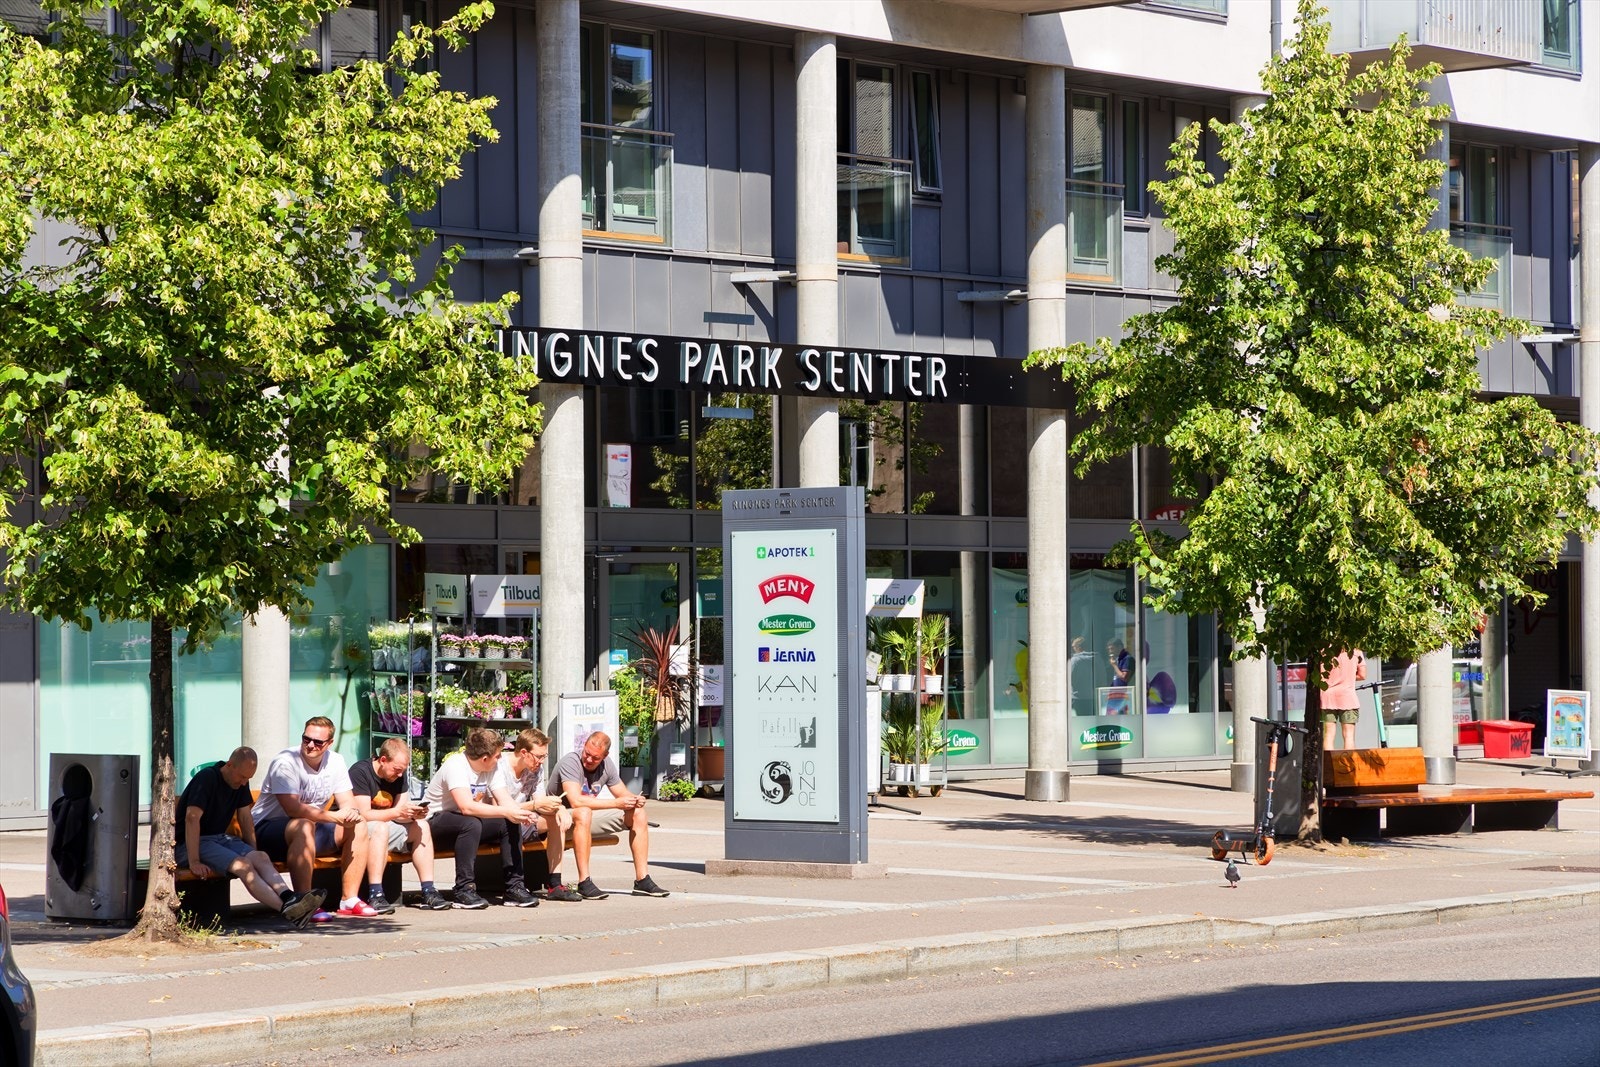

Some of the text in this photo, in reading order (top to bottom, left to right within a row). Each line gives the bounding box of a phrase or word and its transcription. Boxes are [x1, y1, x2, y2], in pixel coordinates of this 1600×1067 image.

[493, 329, 948, 398] INGNES PARK SENTER
[732, 496, 836, 510] RINGNES PARK SENTER
[767, 547, 808, 557] APOTEK
[435, 584, 452, 599] Tilbud
[501, 585, 540, 600] Tilbud
[763, 579, 809, 597] MENY
[872, 594, 906, 606] Tilbud
[761, 618, 812, 629] Mester Grønn
[758, 675, 817, 693] KAN
[572, 703, 605, 716] Tilbud
[952, 733, 976, 747] Grønn
[1083, 729, 1131, 743] Mester Grønn
[798, 760, 815, 776] JO
[799, 776, 816, 791] N
[798, 791, 817, 807] OE
